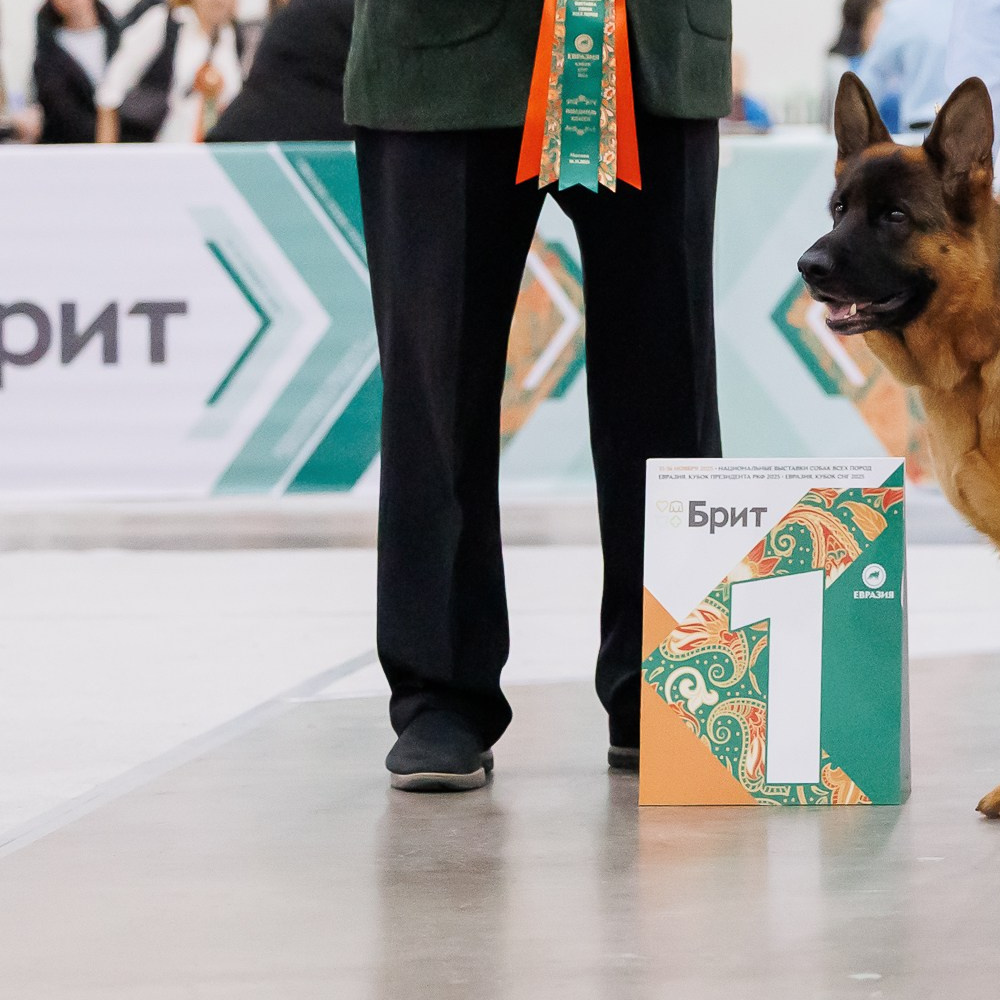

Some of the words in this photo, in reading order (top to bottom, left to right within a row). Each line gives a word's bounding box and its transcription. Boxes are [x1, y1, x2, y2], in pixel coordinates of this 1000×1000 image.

[688, 500, 768, 534] Брит
[854, 590, 894, 599] ЕВРАЗИЯ
[730, 570, 824, 784] 1
